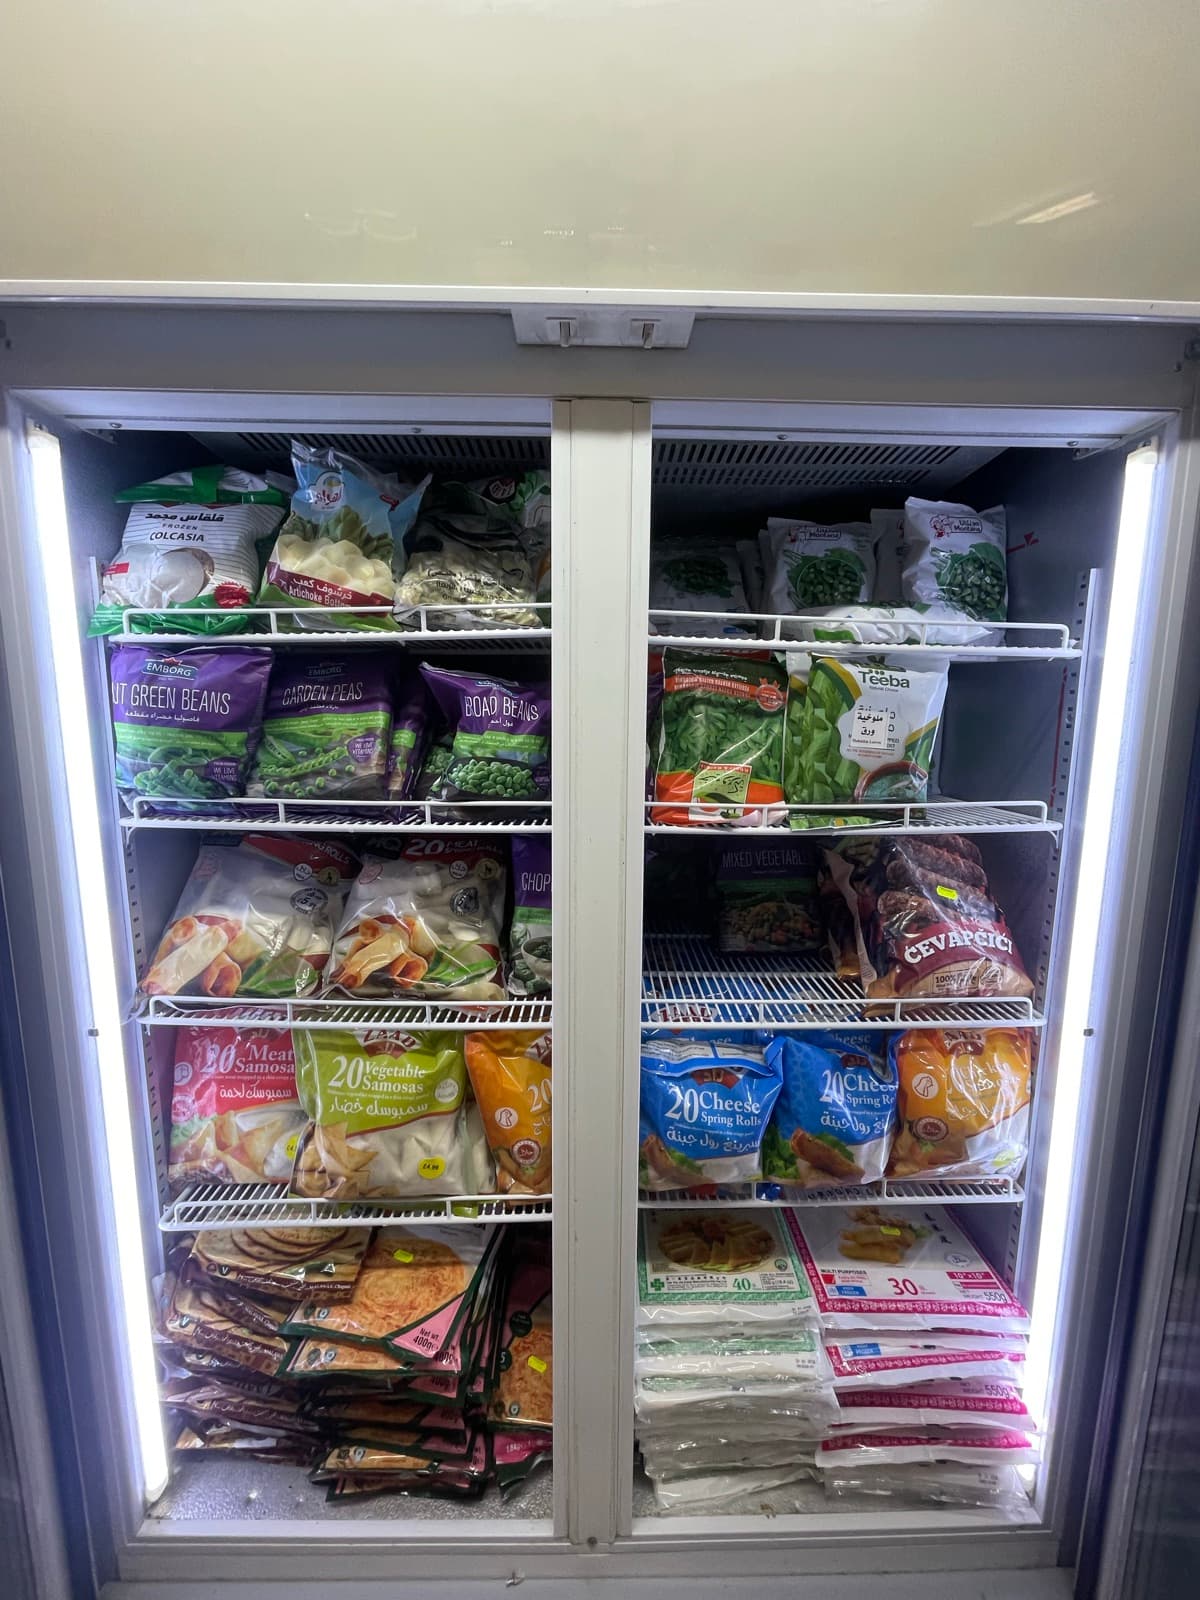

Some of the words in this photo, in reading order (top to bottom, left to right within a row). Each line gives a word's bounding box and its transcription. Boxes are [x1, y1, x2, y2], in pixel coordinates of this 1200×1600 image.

[145, 512, 178, 521] مجمد
[180, 511, 225, 522] قلقاس
[162, 523, 199, 531] FROZEN
[150, 531, 205, 543] COLCASIA
[288, 585, 323, 603] Artichoke
[146, 662, 193, 677] EMBORG
[858, 669, 910, 688] Teeba
[131, 683, 176, 709] GREEN
[181, 688, 231, 715] BEANS
[331, 682, 364, 701] PEAS
[503, 697, 539, 721] BEANS
[857, 712, 884, 723] ملوخية
[860, 726, 875, 737] ورق
[406, 838, 445, 856] 20
[721, 851, 753, 868] MIXED
[201, 1043, 236, 1073] 20
[249, 1044, 294, 1062] Meat
[234, 1058, 295, 1074] Samosa
[328, 1055, 364, 1089] 20
[365, 1060, 426, 1080] Vegetable
[219, 1083, 245, 1099] لحمة
[363, 1075, 424, 1094] Samosas
[820, 1070, 845, 1105] 20
[528, 1078, 552, 1113] 20
[846, 1093, 880, 1108] Spring
[665, 1085, 699, 1124] 20
[700, 1090, 761, 1115] Cheese
[701, 1112, 733, 1128] Spring
[736, 1114, 762, 1126] Rolls
[666, 1126, 698, 1147] جبنة
[700, 1133, 720, 1149] رول
[732, 1278, 752, 1291] 40
[887, 1277, 919, 1296] 30
[984, 1291, 1008, 1304] 550g
[419, 1327, 431, 1338] Net
[412, 1335, 434, 1351] 400g
[984, 1385, 1010, 1398] 550g
